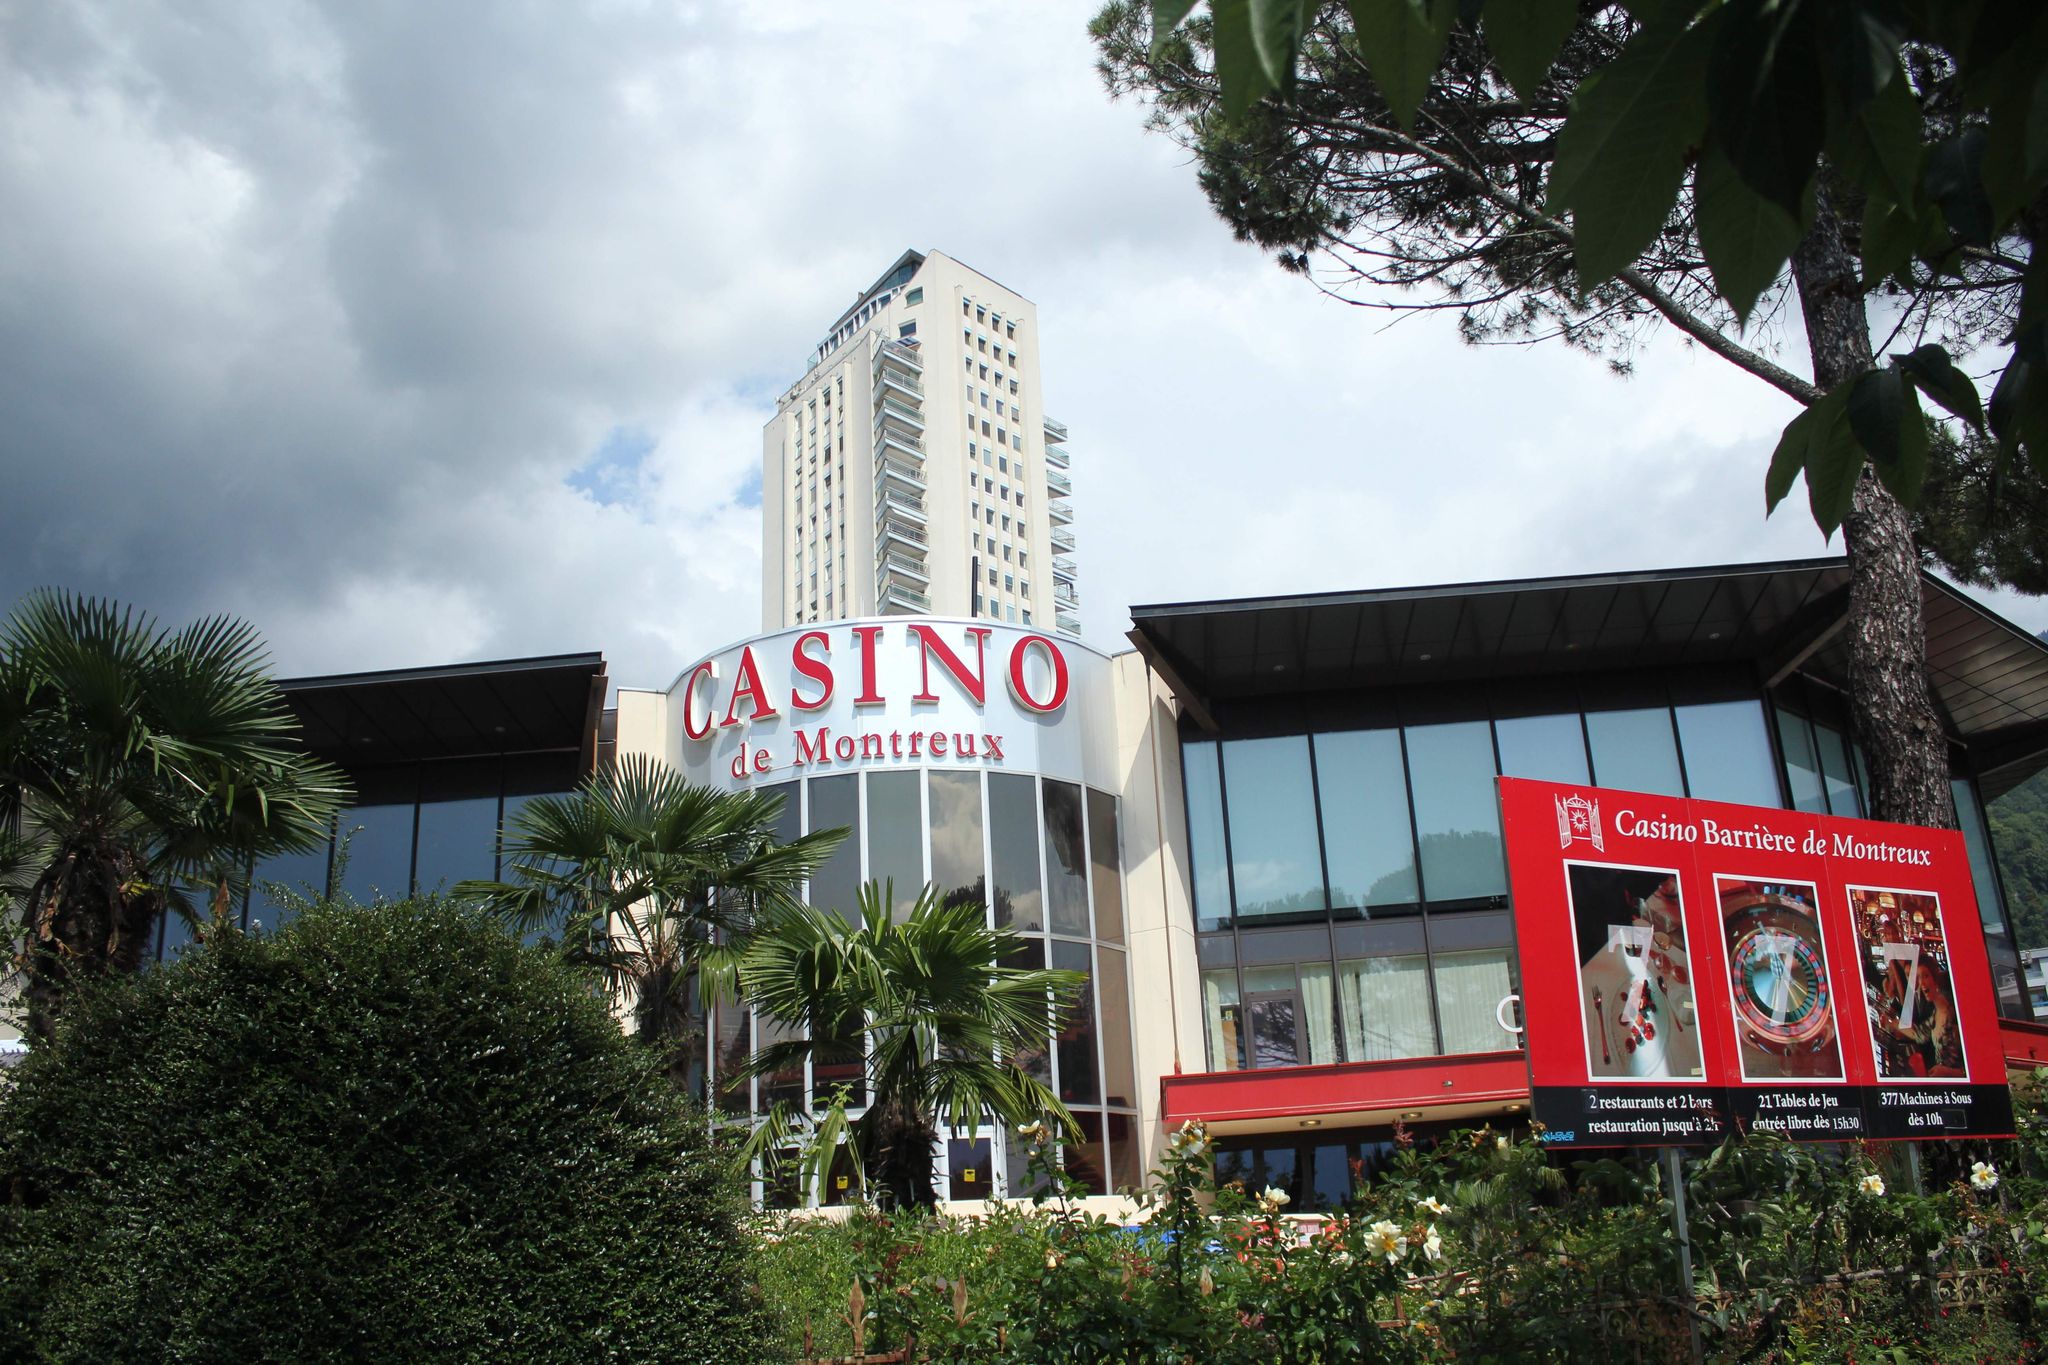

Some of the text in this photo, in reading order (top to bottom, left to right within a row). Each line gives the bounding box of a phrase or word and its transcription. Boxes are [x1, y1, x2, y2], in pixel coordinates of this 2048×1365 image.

[683, 624, 1070, 742] CASINO
[730, 726, 1005, 779] de Montreux
[1615, 809, 1932, 866] Casino Barrière de Montreux
[1883, 942, 1920, 1030] 7
[1589, 1094, 1598, 1109] 2
[1599, 1094, 1665, 1110] restaurants
[1667, 1095, 1678, 1109] et
[1679, 1094, 1687, 1109] 2
[1758, 1093, 1839, 1109] 21 Tables de Jeu
[1880, 1091, 1972, 1106] 377 Machines à Sous
[1588, 1118, 1661, 1133] restauration
[1661, 1117, 1702, 1136] jusqu'à
[1752, 1115, 1860, 1130] entrée libre dès 15h30
[1908, 1112, 1944, 1126] dès 10h
